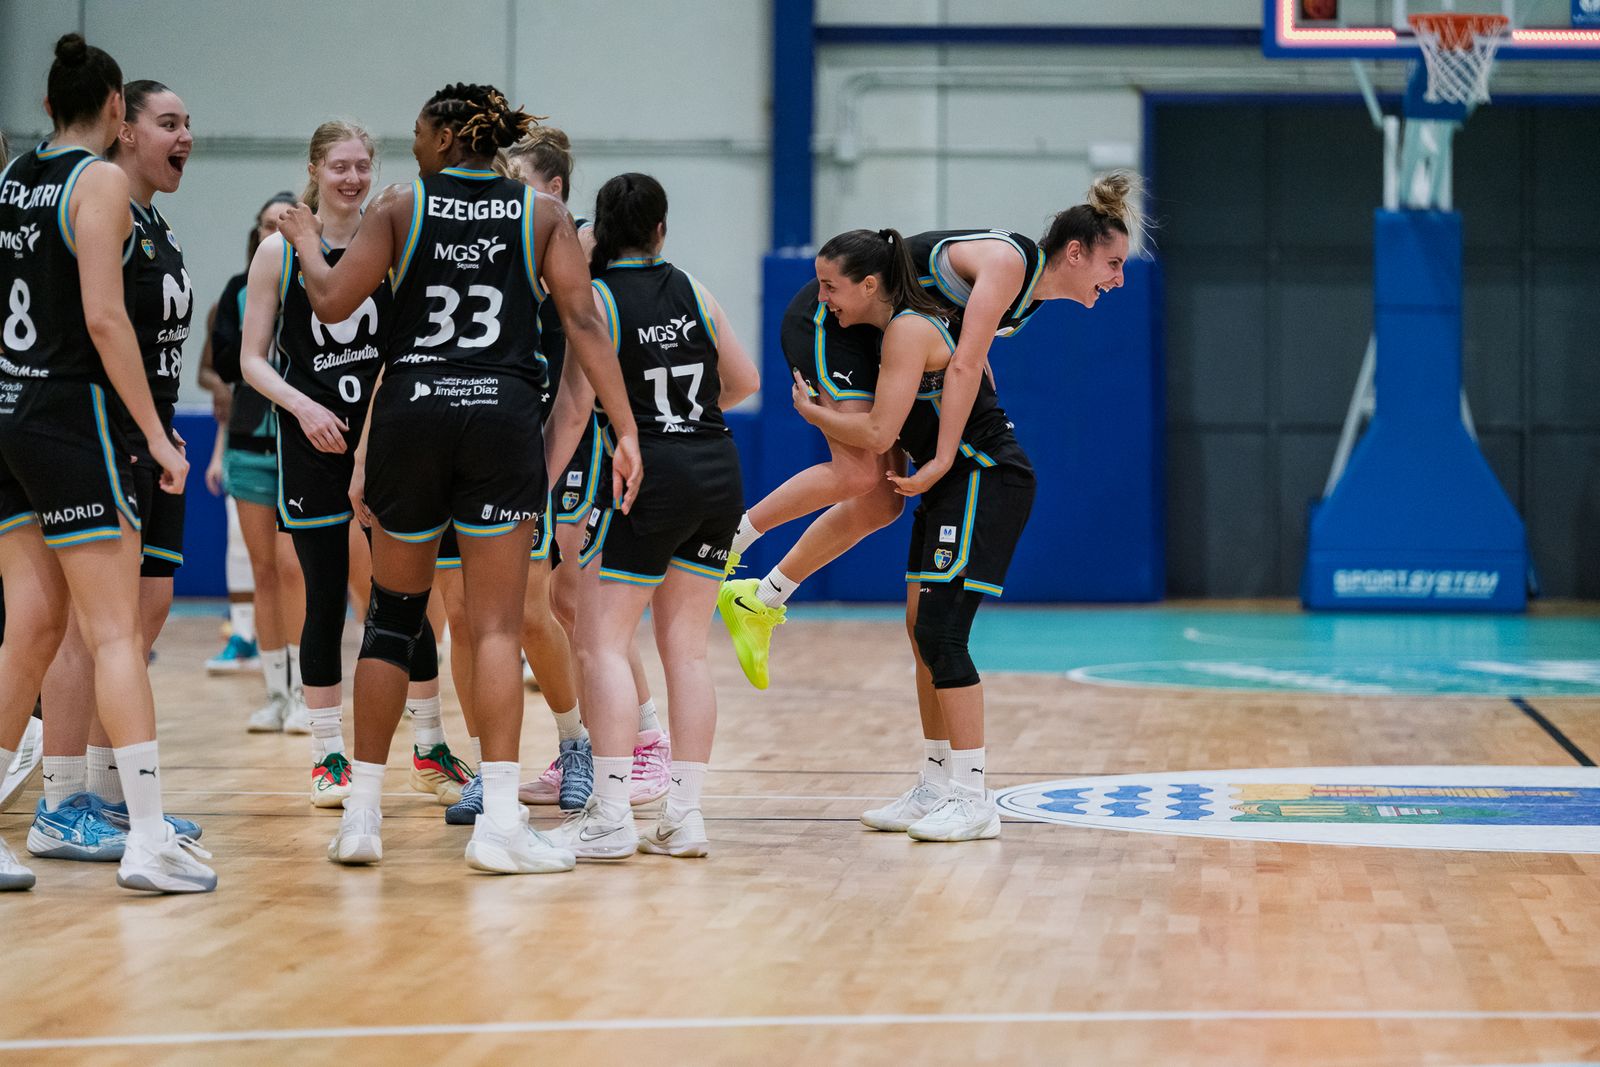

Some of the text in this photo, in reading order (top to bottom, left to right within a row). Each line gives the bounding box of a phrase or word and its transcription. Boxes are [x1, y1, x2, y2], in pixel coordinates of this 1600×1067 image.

[427, 195, 522, 221] EZEIGBO
[433, 242, 481, 262] MGS
[3, 278, 38, 351] 8
[413, 284, 504, 349] 33
[637, 324, 678, 345] MGS
[156, 347, 183, 379] 18
[313, 343, 379, 372] Estudiantes
[338, 375, 362, 404] 0
[473, 384, 499, 396] Díaz
[643, 362, 705, 424] 17
[42, 503, 105, 526] MADRID
